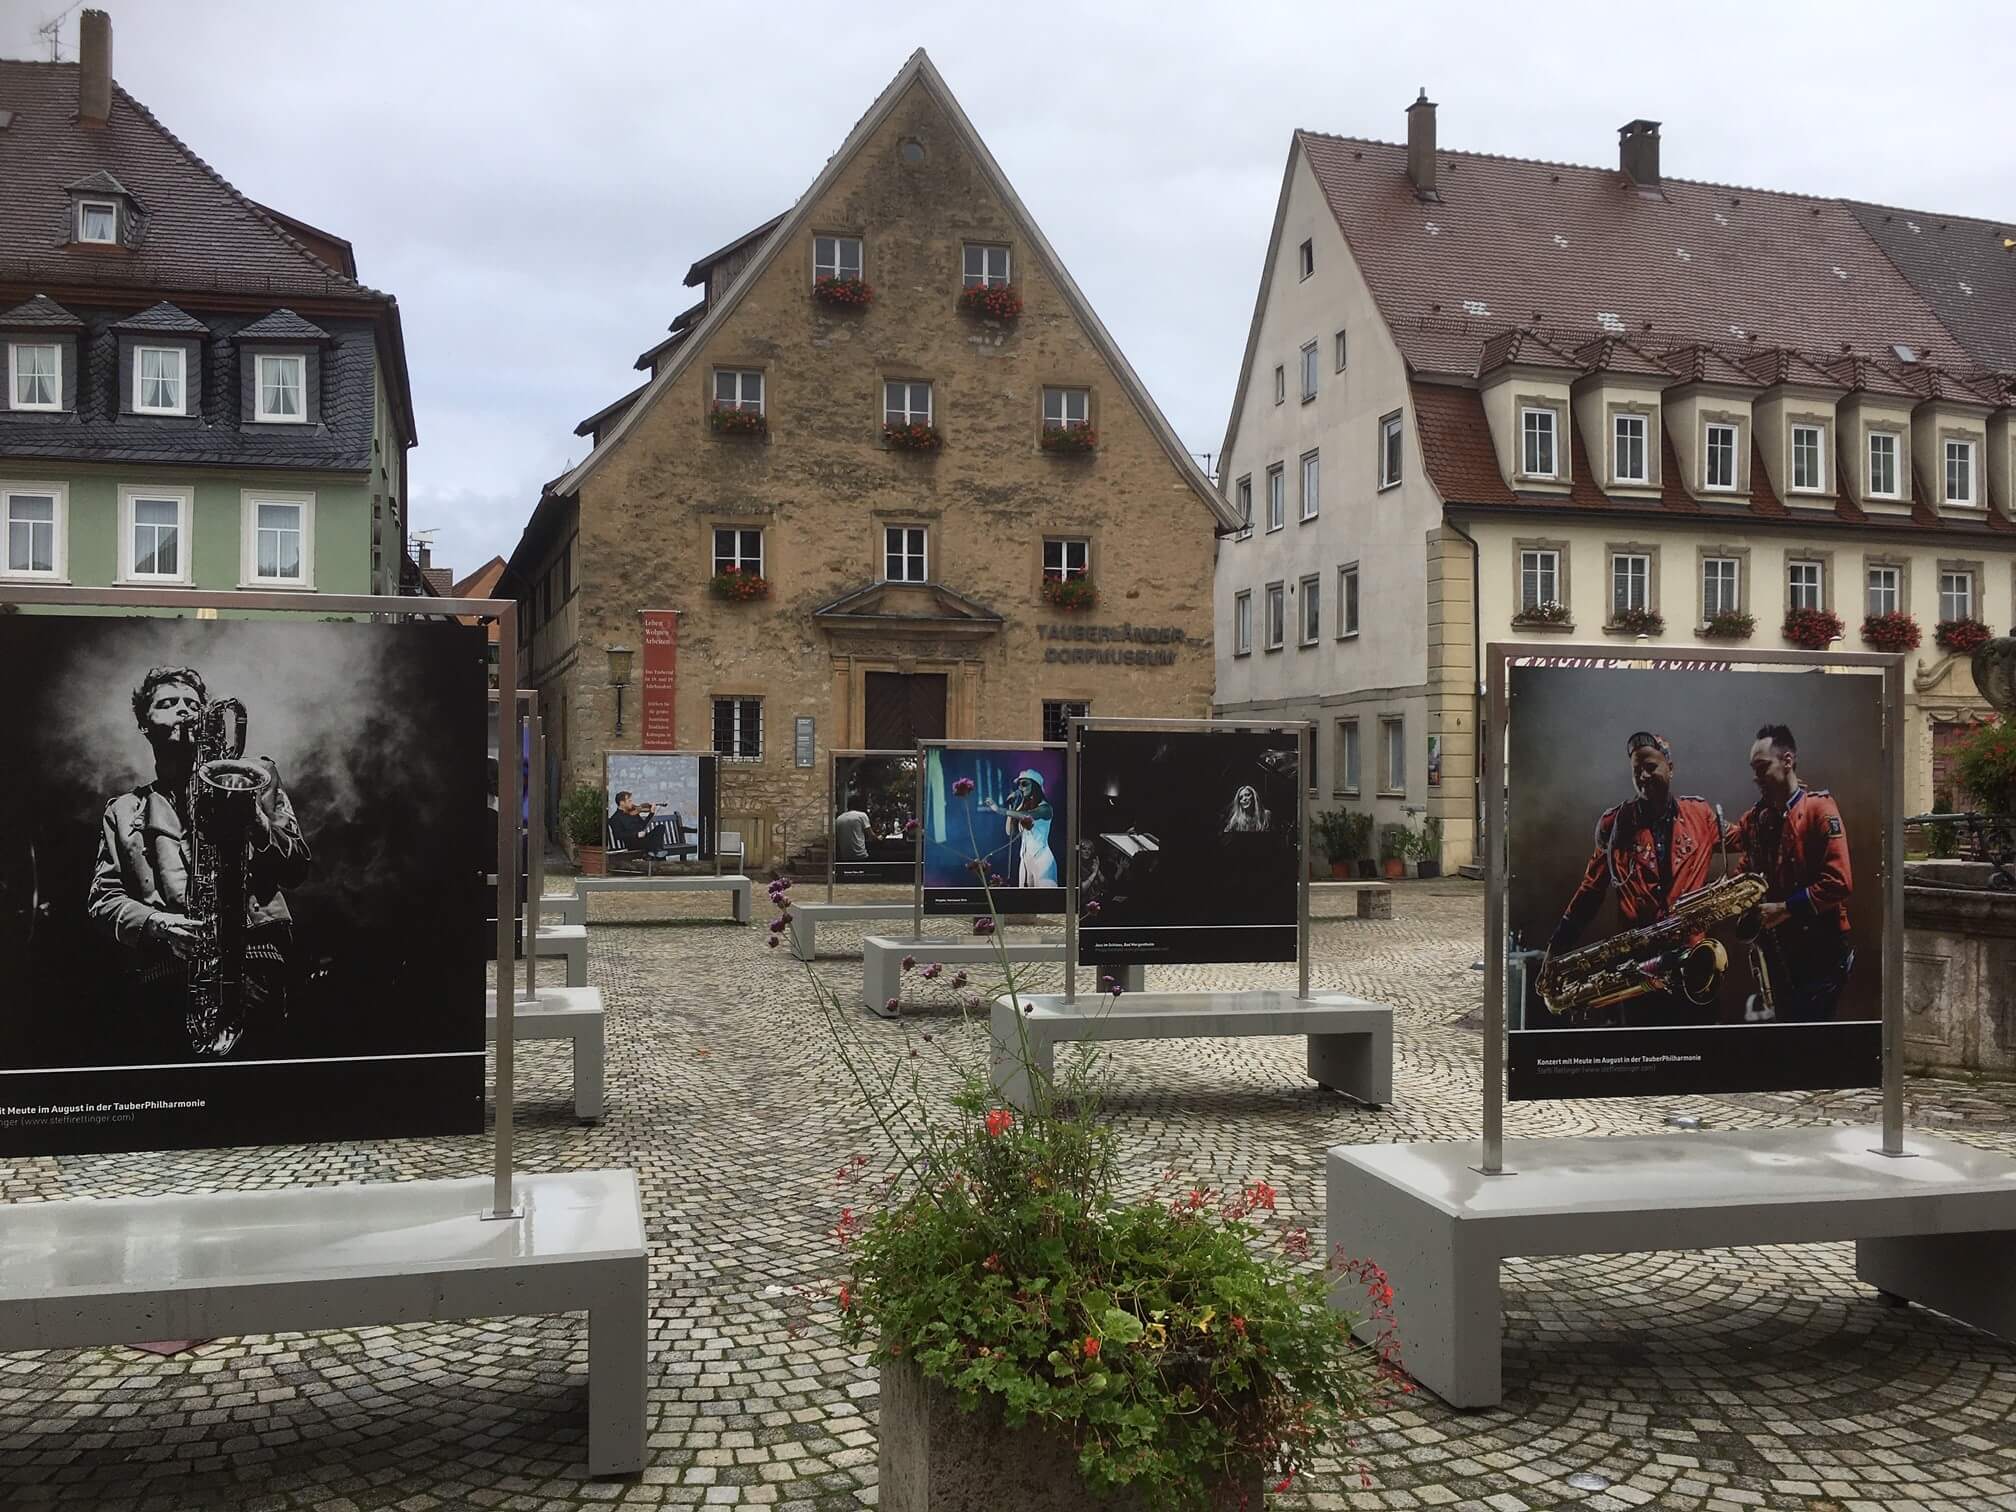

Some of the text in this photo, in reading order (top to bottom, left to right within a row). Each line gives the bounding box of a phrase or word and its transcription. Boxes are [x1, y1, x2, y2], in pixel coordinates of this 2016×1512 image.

[645, 619, 663, 627] Leben
[645, 628, 669, 637] Wohnen
[1036, 623, 1185, 644] TAUBERLÄNDER
[645, 638, 671, 646] Arbeiten
[1044, 647, 1178, 666] DORFMUSEUM
[1536, 1053, 1702, 1066] Konzert mit Meute im August in der TauberPhilharmonie
[7, 1106, 37, 1115] Meute
[38, 1105, 50, 1114] im
[51, 1104, 84, 1116] August
[86, 1103, 95, 1112] in
[96, 1102, 112, 1112] der
[113, 1098, 206, 1111] TauberPhilharmonie
